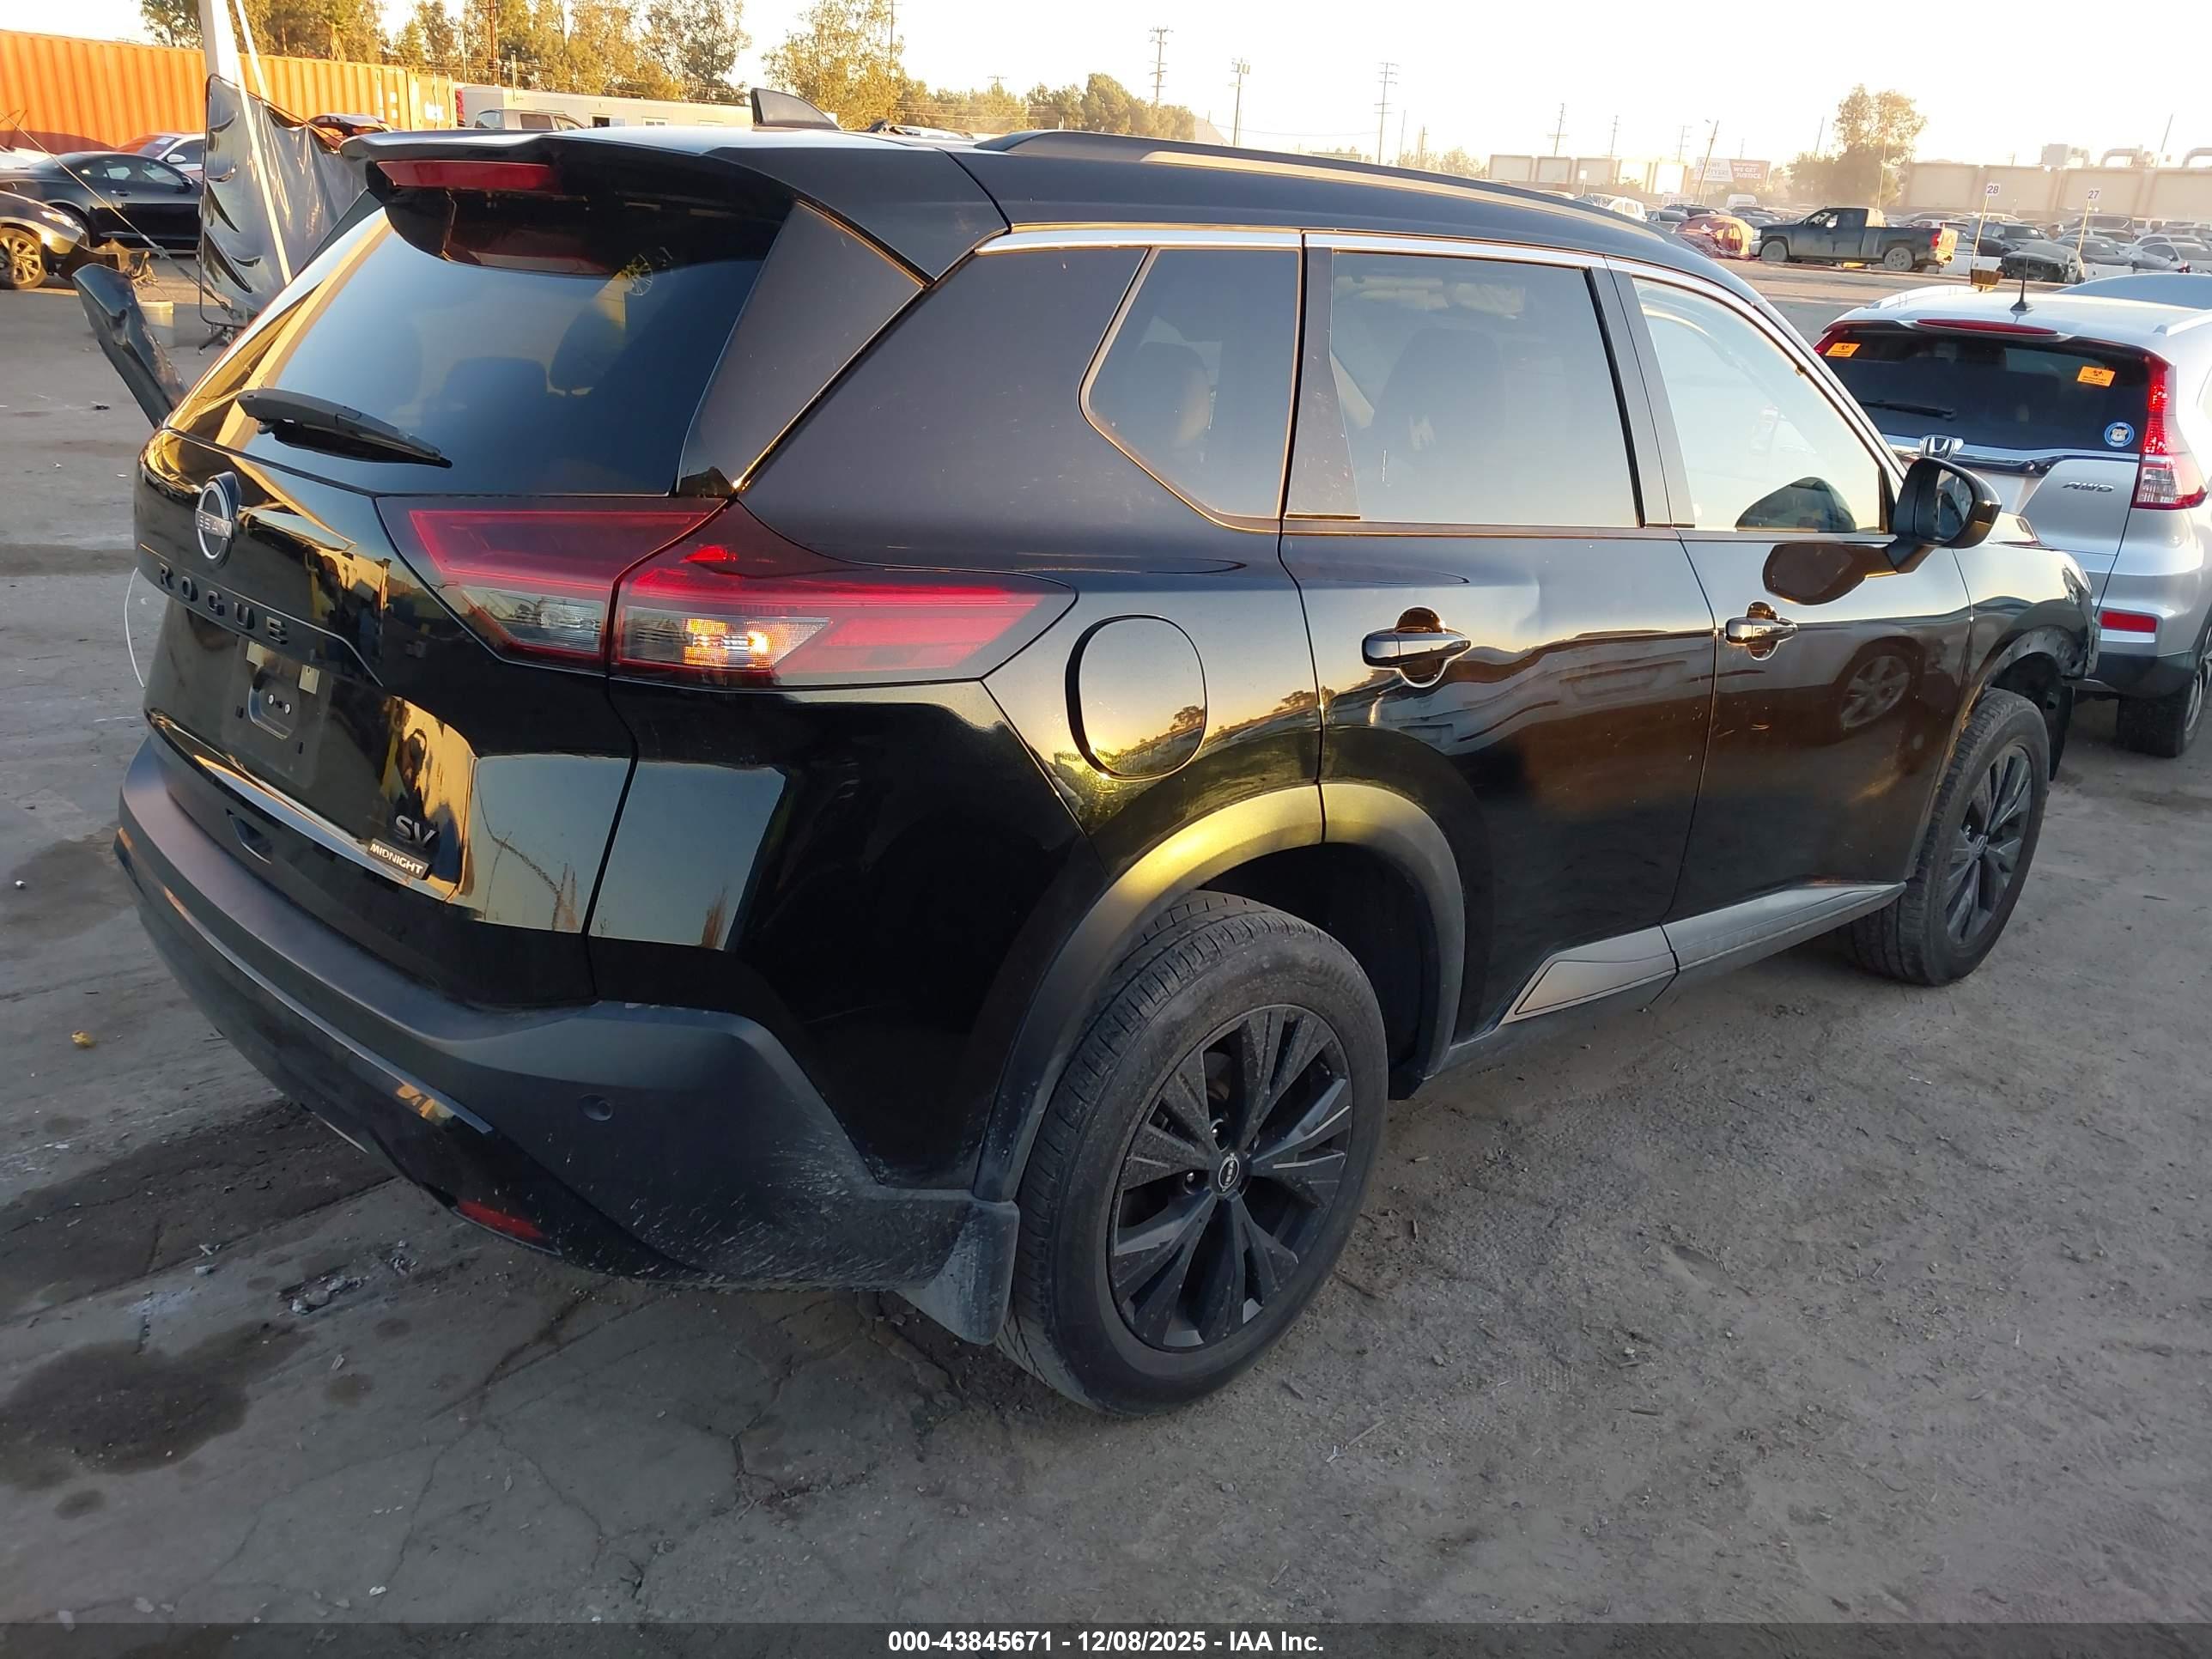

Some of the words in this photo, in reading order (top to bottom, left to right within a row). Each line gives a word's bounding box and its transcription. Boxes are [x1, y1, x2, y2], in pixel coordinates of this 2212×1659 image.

[1987, 185, 1999, 194] 28
[2087, 190, 2100, 199] 27
[2063, 481, 2114, 492] AWD
[158, 562, 289, 644] ROGUE
[395, 815, 437, 847] SV
[370, 843, 423, 874] MIDNIGHT
